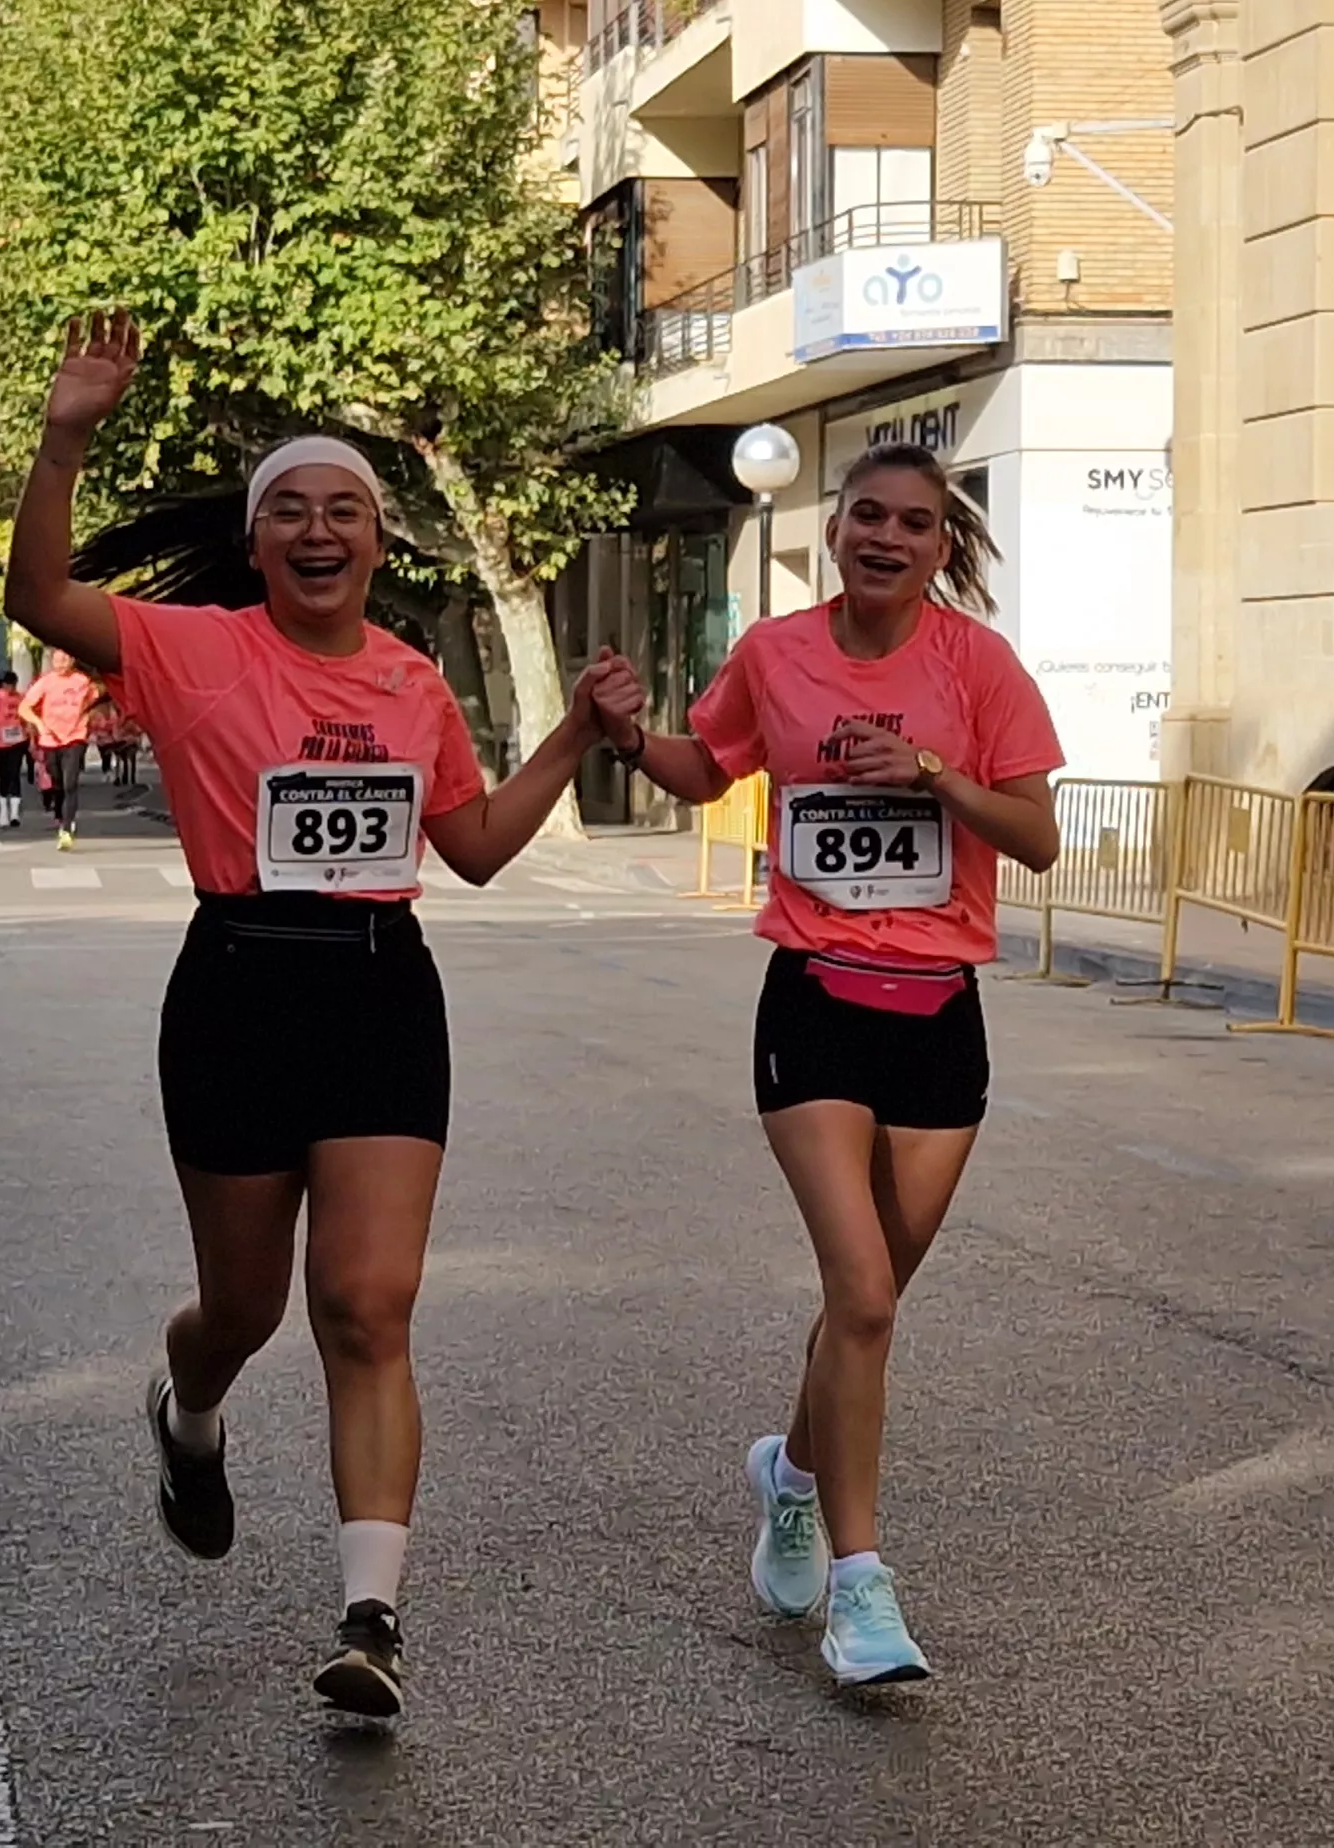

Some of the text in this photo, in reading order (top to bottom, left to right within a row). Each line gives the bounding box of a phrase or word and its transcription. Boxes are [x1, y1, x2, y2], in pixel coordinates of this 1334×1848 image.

[279, 786, 407, 802] CONTRA EL CÁNCER
[798, 808, 856, 822] CONTRA
[291, 807, 389, 856] 893
[814, 826, 920, 874] 894
